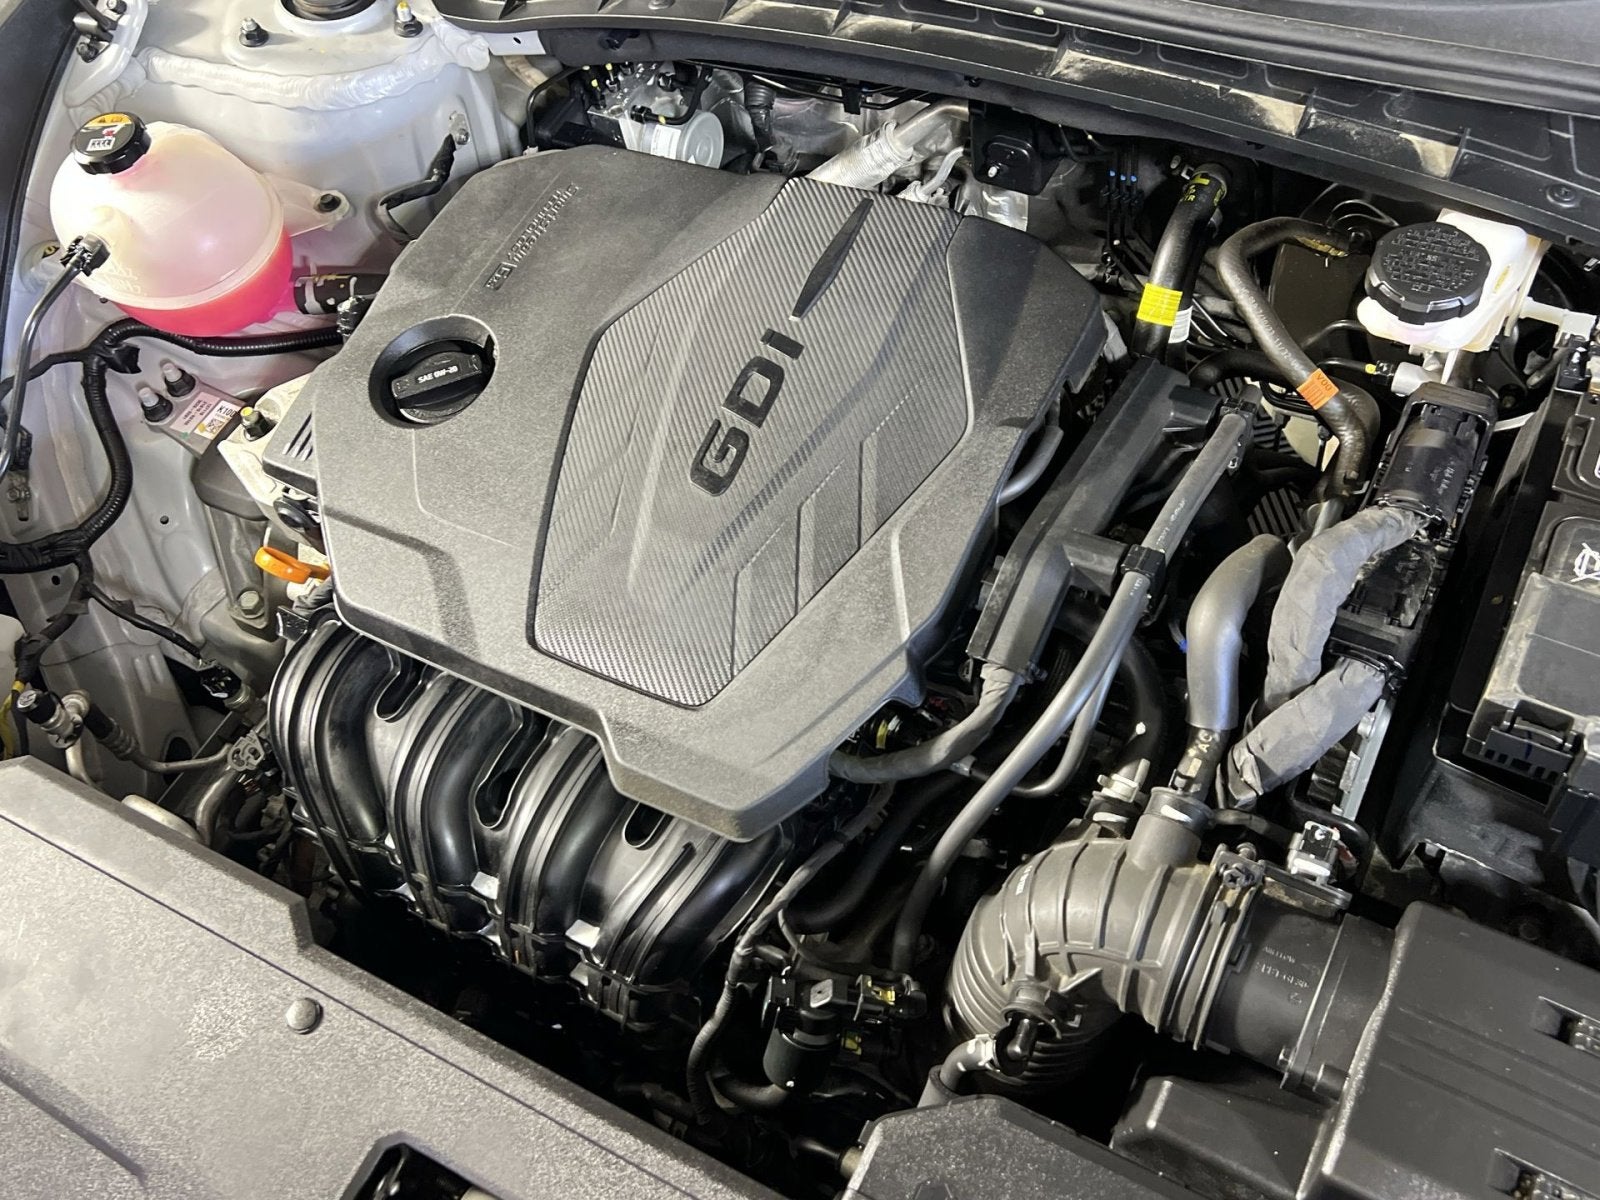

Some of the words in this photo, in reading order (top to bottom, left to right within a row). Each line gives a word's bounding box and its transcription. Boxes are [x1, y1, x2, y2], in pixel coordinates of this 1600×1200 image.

[507, 189, 562, 261] TECHNOLOGY
[512, 181, 580, 263] Smartstream
[417, 373, 433, 384] SAE
[433, 365, 459, 379] 0W-20
[689, 328, 805, 497] GDI
